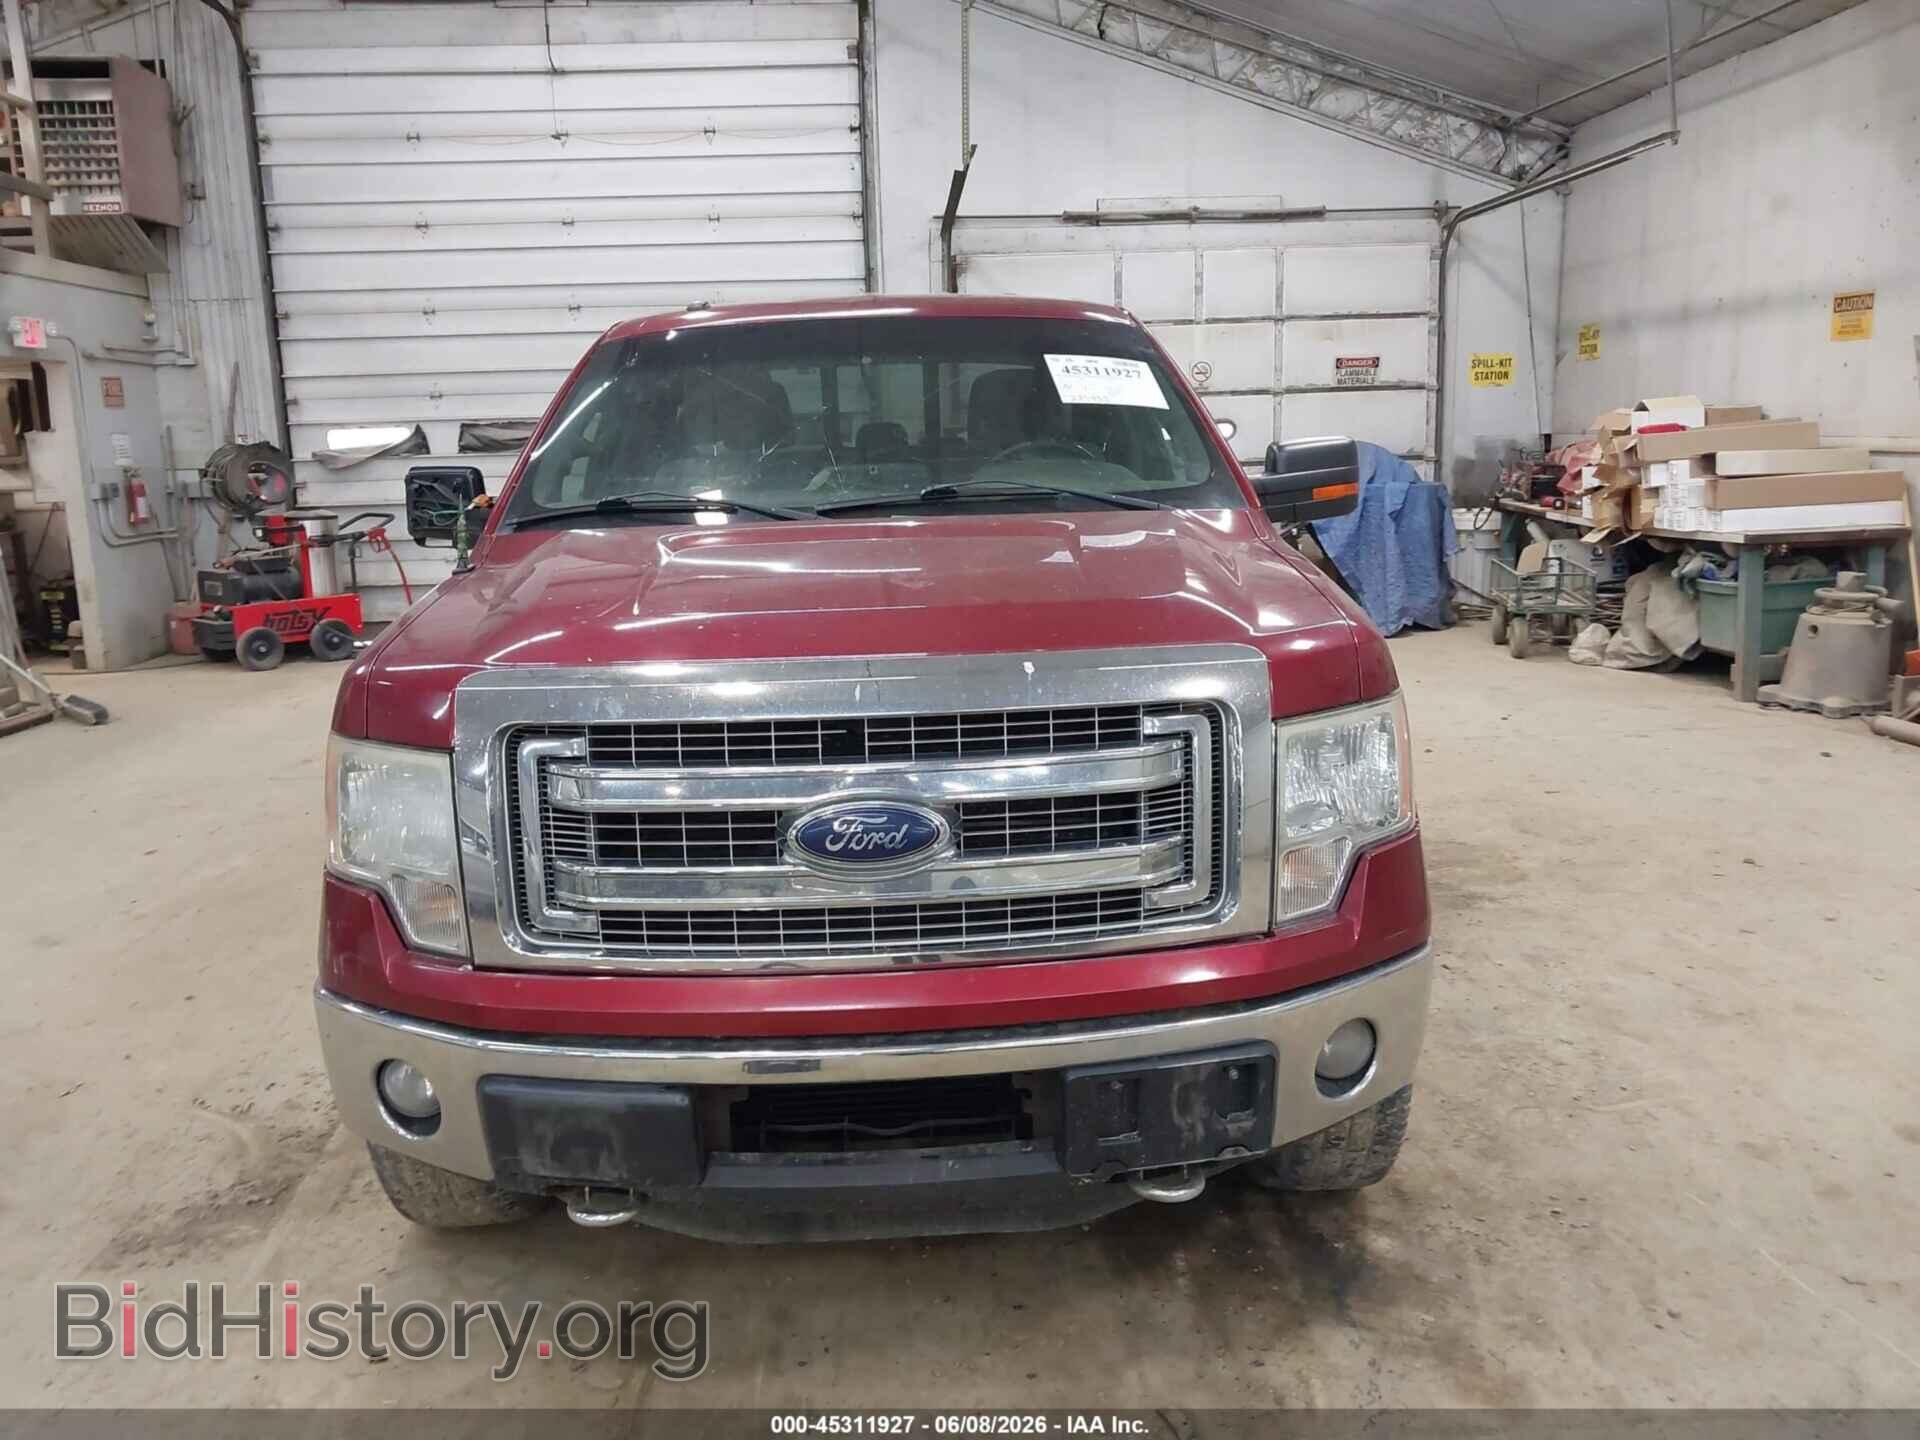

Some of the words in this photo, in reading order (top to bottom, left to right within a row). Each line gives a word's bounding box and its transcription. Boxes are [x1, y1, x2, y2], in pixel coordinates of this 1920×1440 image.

[1835, 296, 1873, 311] CAUTION
[1342, 359, 1374, 367] DANGER
[1471, 358, 1513, 369] SPILL-KIT
[1061, 365, 1142, 379] 45311927
[1335, 368, 1377, 376] FLAMMABLE
[1473, 370, 1510, 381] STATION
[1336, 376, 1376, 385] MATERIALS
[825, 816, 909, 852] Ford
